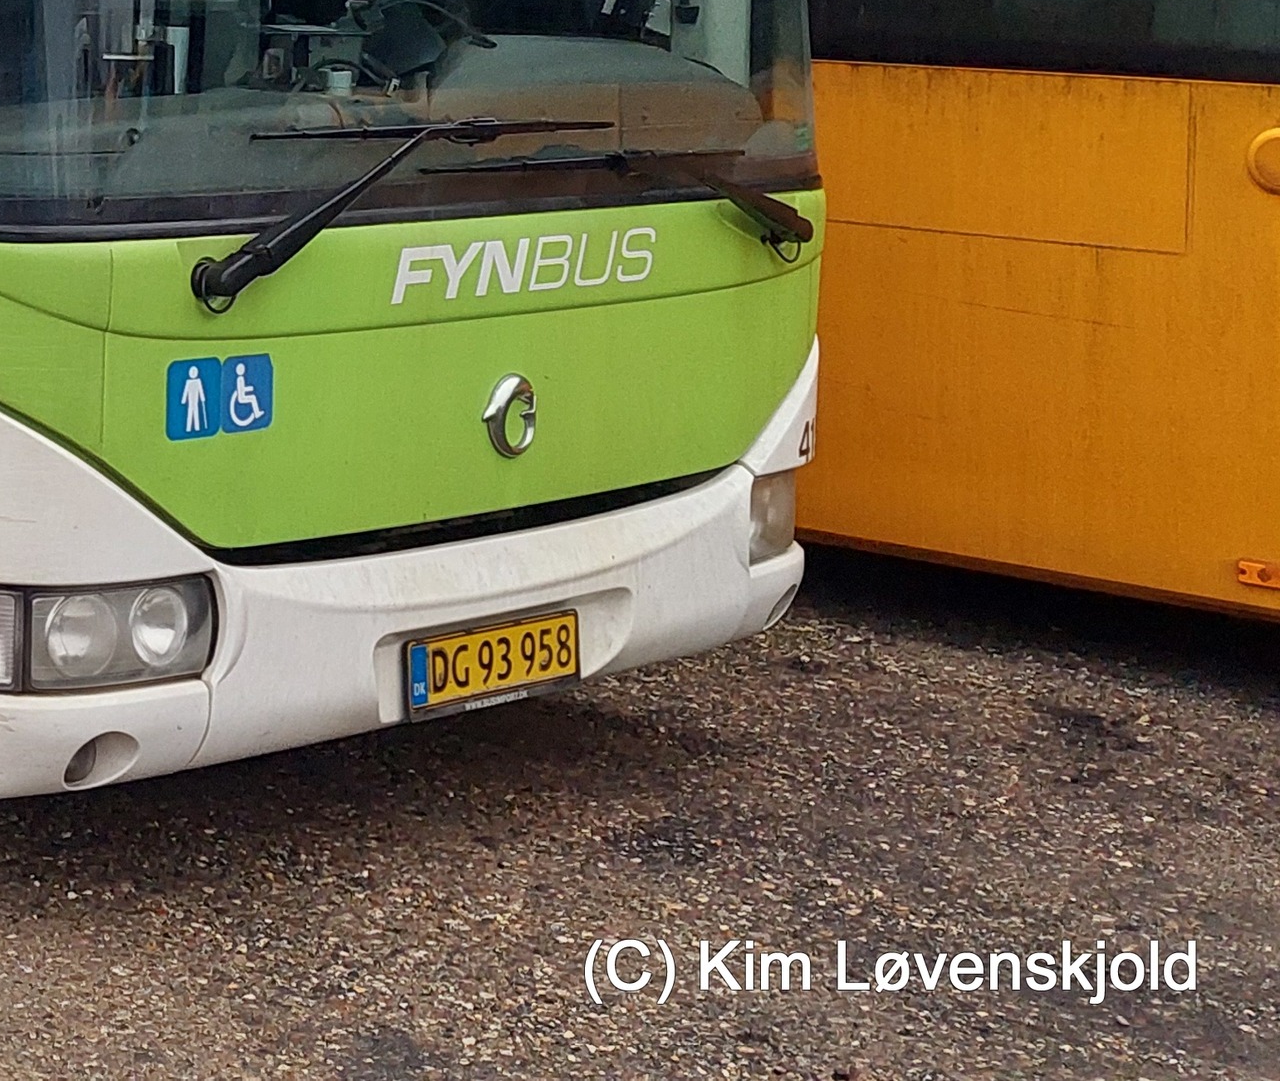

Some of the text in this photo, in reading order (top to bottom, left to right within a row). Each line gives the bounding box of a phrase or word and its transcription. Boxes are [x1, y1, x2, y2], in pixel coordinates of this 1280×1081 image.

[391, 227, 657, 305] FYNBUS
[413, 682, 426, 696] DK
[431, 624, 572, 694] DG 93 958
